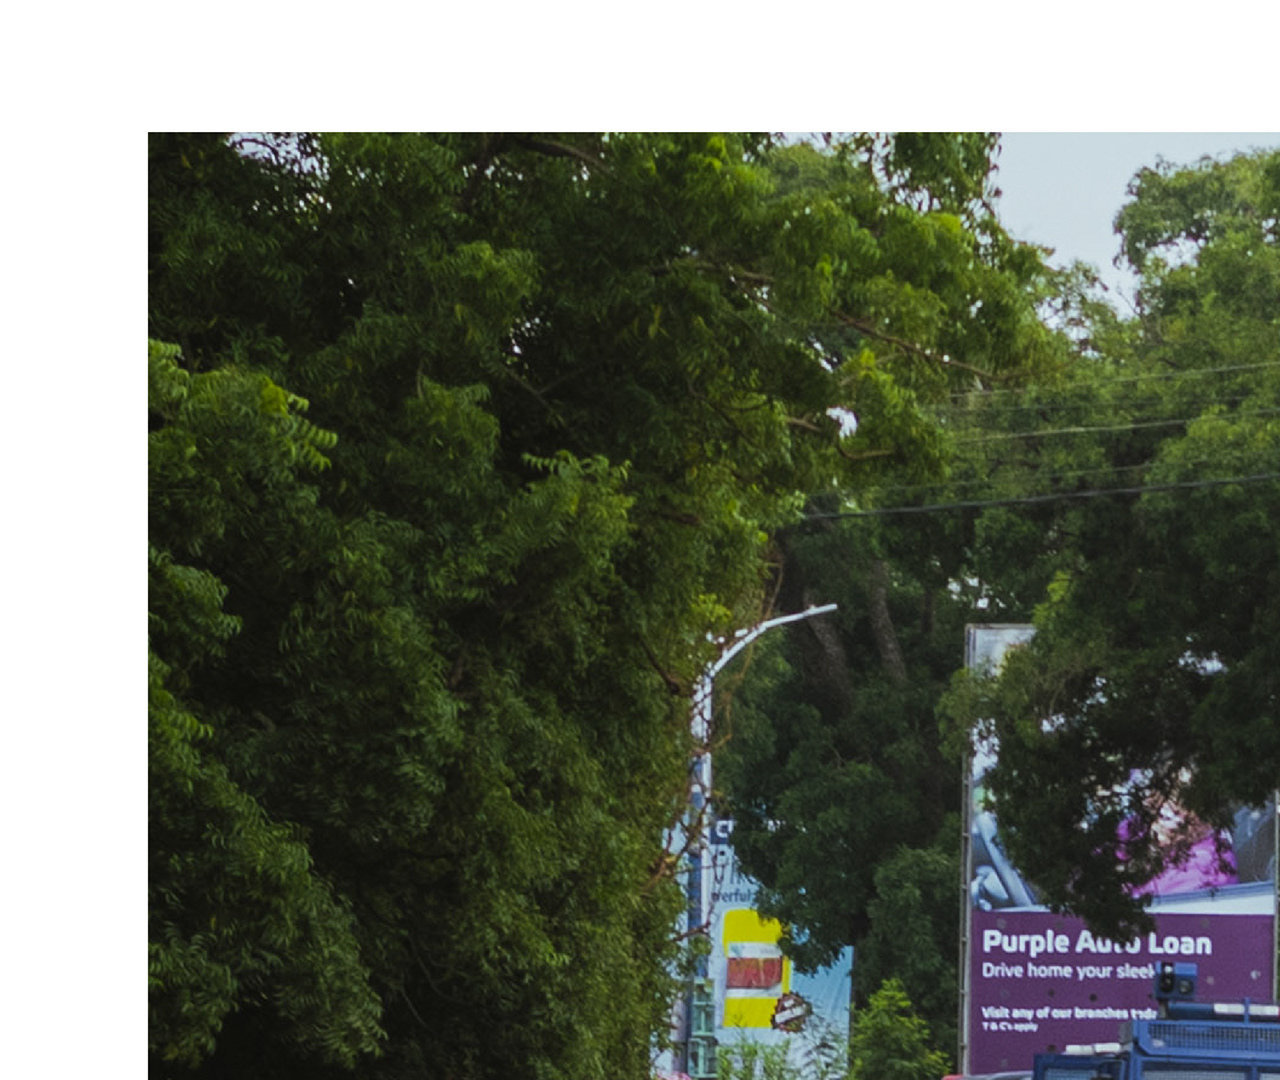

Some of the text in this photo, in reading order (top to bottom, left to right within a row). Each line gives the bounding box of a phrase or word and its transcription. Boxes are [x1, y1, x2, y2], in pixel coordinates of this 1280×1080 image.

[983, 929, 1070, 958] Purple
[1149, 931, 1213, 955] Loan
[982, 961, 1023, 978] Drive
[1028, 962, 1073, 978] home
[1076, 965, 1113, 981] your
[981, 1006, 1010, 1018] Visit
[1012, 1008, 1034, 1020] any
[1036, 1006, 1050, 1018] of
[1051, 1008, 1072, 1018] our
[1074, 1006, 1129, 1019] branches
